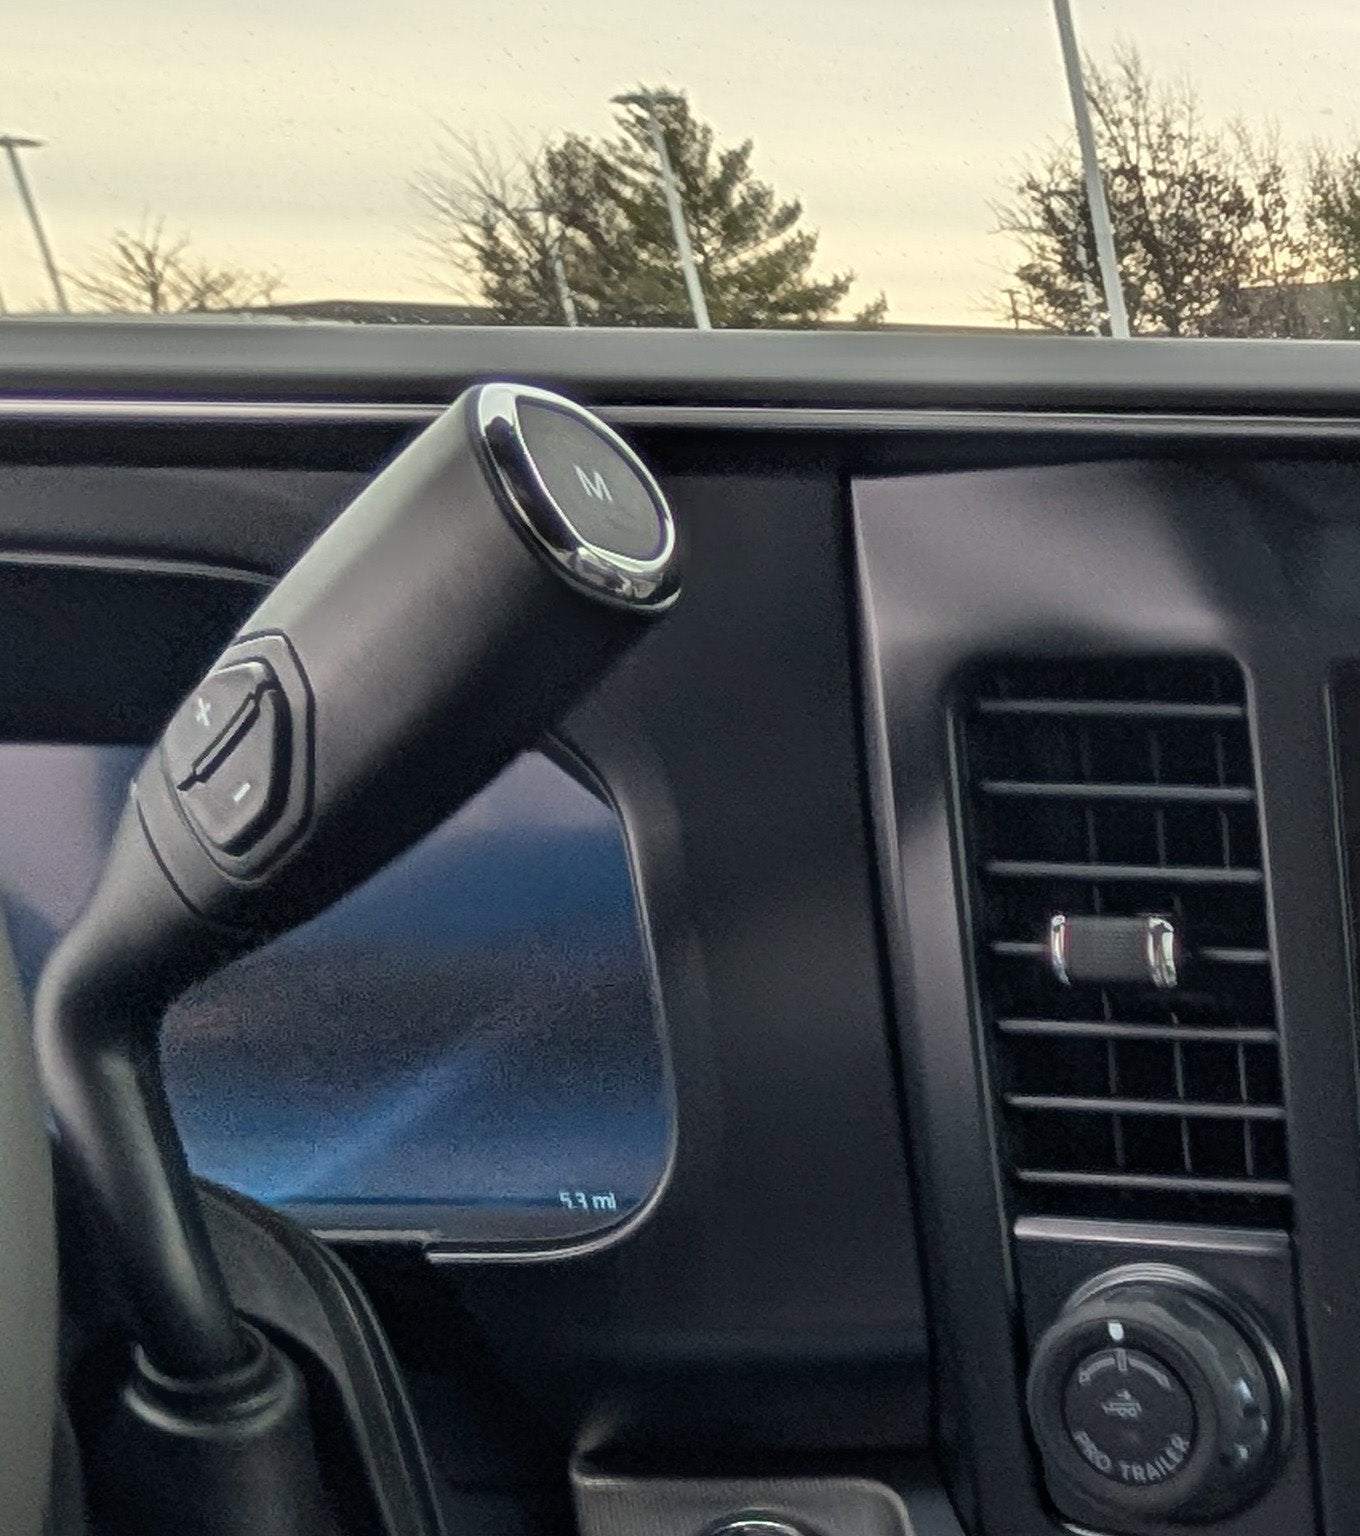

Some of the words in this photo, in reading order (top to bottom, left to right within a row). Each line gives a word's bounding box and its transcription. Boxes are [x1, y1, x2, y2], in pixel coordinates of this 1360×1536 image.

[573, 465, 613, 501] M
[1073, 1431, 1112, 1472] PRO
[1121, 1434, 1190, 1481] TRAILER
